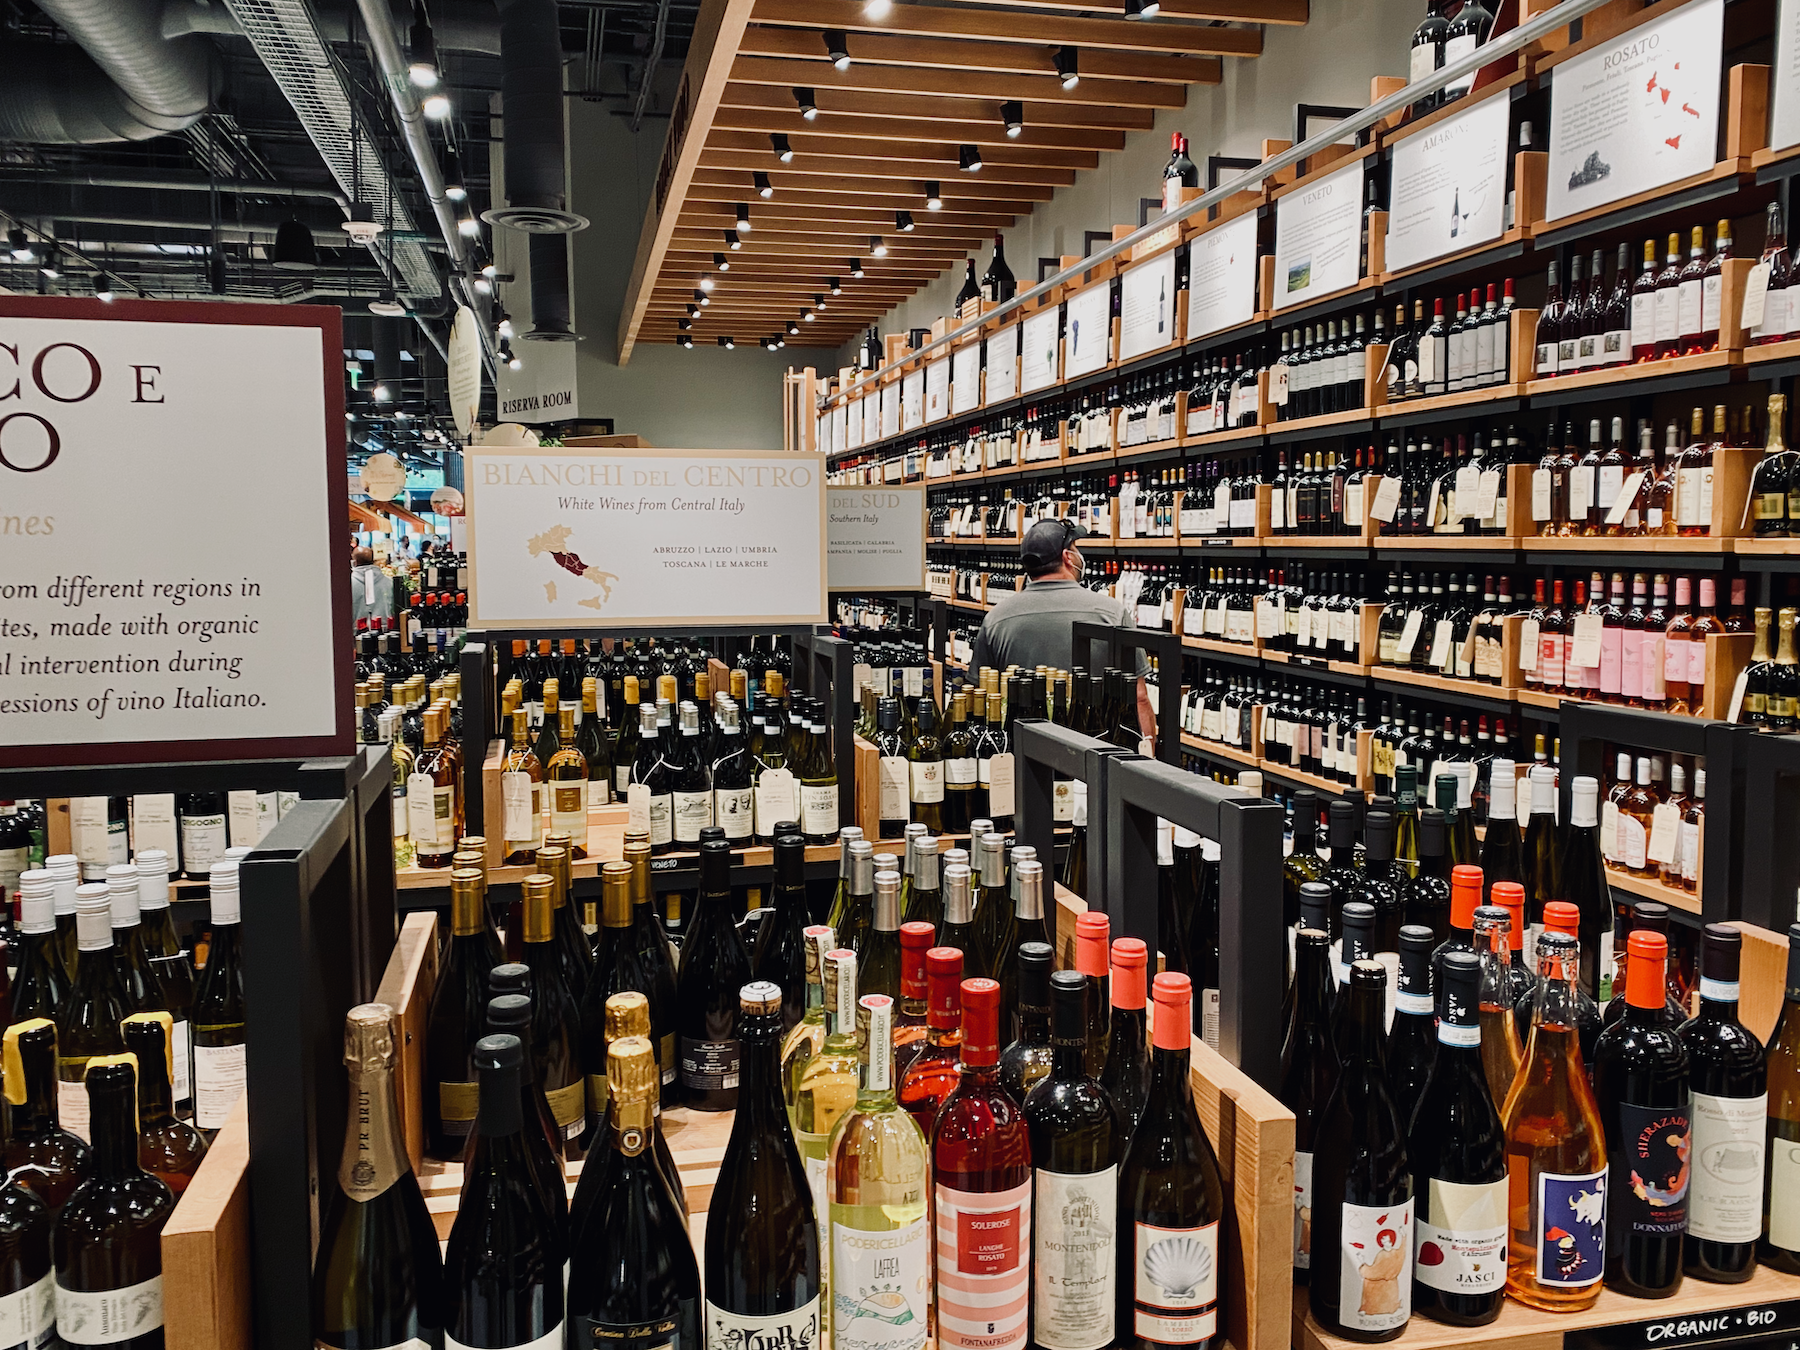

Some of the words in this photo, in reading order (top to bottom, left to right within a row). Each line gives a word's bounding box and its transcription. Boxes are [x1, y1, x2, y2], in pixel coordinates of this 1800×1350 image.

[1603, 34, 1660, 70] ROSATO
[1302, 184, 1333, 206] VENETO
[128, 364, 165, 404] E
[502, 396, 540, 414] RISERVA
[543, 391, 572, 408] ROOM
[482, 463, 624, 486] BIANCHI
[633, 471, 676, 487] DEL
[684, 465, 812, 488] CENTRO
[558, 496, 595, 511] White
[599, 496, 634, 511] Wines
[636, 497, 667, 515] from
[671, 497, 716, 511] Central
[719, 498, 746, 516] Italy
[832, 498, 858, 509] DEL
[861, 494, 900, 509] SUD
[829, 513, 861, 523] Southern
[863, 514, 879, 526] Italy
[653, 546, 695, 554] ABRUZZO
[704, 546, 732, 554] LAZIO
[741, 546, 778, 554] UMBRIA
[662, 560, 707, 568] TOSCANA
[716, 560, 727, 568] LE
[730, 560, 769, 568] MARCHE
[0, 584, 38, 599] om
[47, 576, 144, 606] different
[152, 577, 233, 605] regions
[240, 577, 261, 598] in
[50, 614, 112, 637] made
[121, 613, 169, 636] with
[177, 614, 259, 642] organic
[20, 652, 160, 676] intervention
[168, 650, 243, 679] during
[0, 690, 78, 713] essions
[86, 688, 113, 719] of
[117, 690, 165, 711] vino
[172, 686, 267, 710] Italiano.
[651, 859, 678, 869] VENETO
[359, 1089, 370, 1124] BRUT
[971, 1218, 1011, 1230] SOLEROSE
[979, 1243, 1004, 1251] LANGHE
[1045, 1237, 1111, 1253] MONTENIDOLI
[978, 1253, 1005, 1261] ROSATO
[1456, 1271, 1495, 1283] JASCI
[1157, 1319, 1200, 1328] LAMELLE
[1646, 1316, 1729, 1342] ORGANIC
[1747, 1310, 1777, 1326] BIO
[960, 1333, 1017, 1348] FONTANAFREDDA
